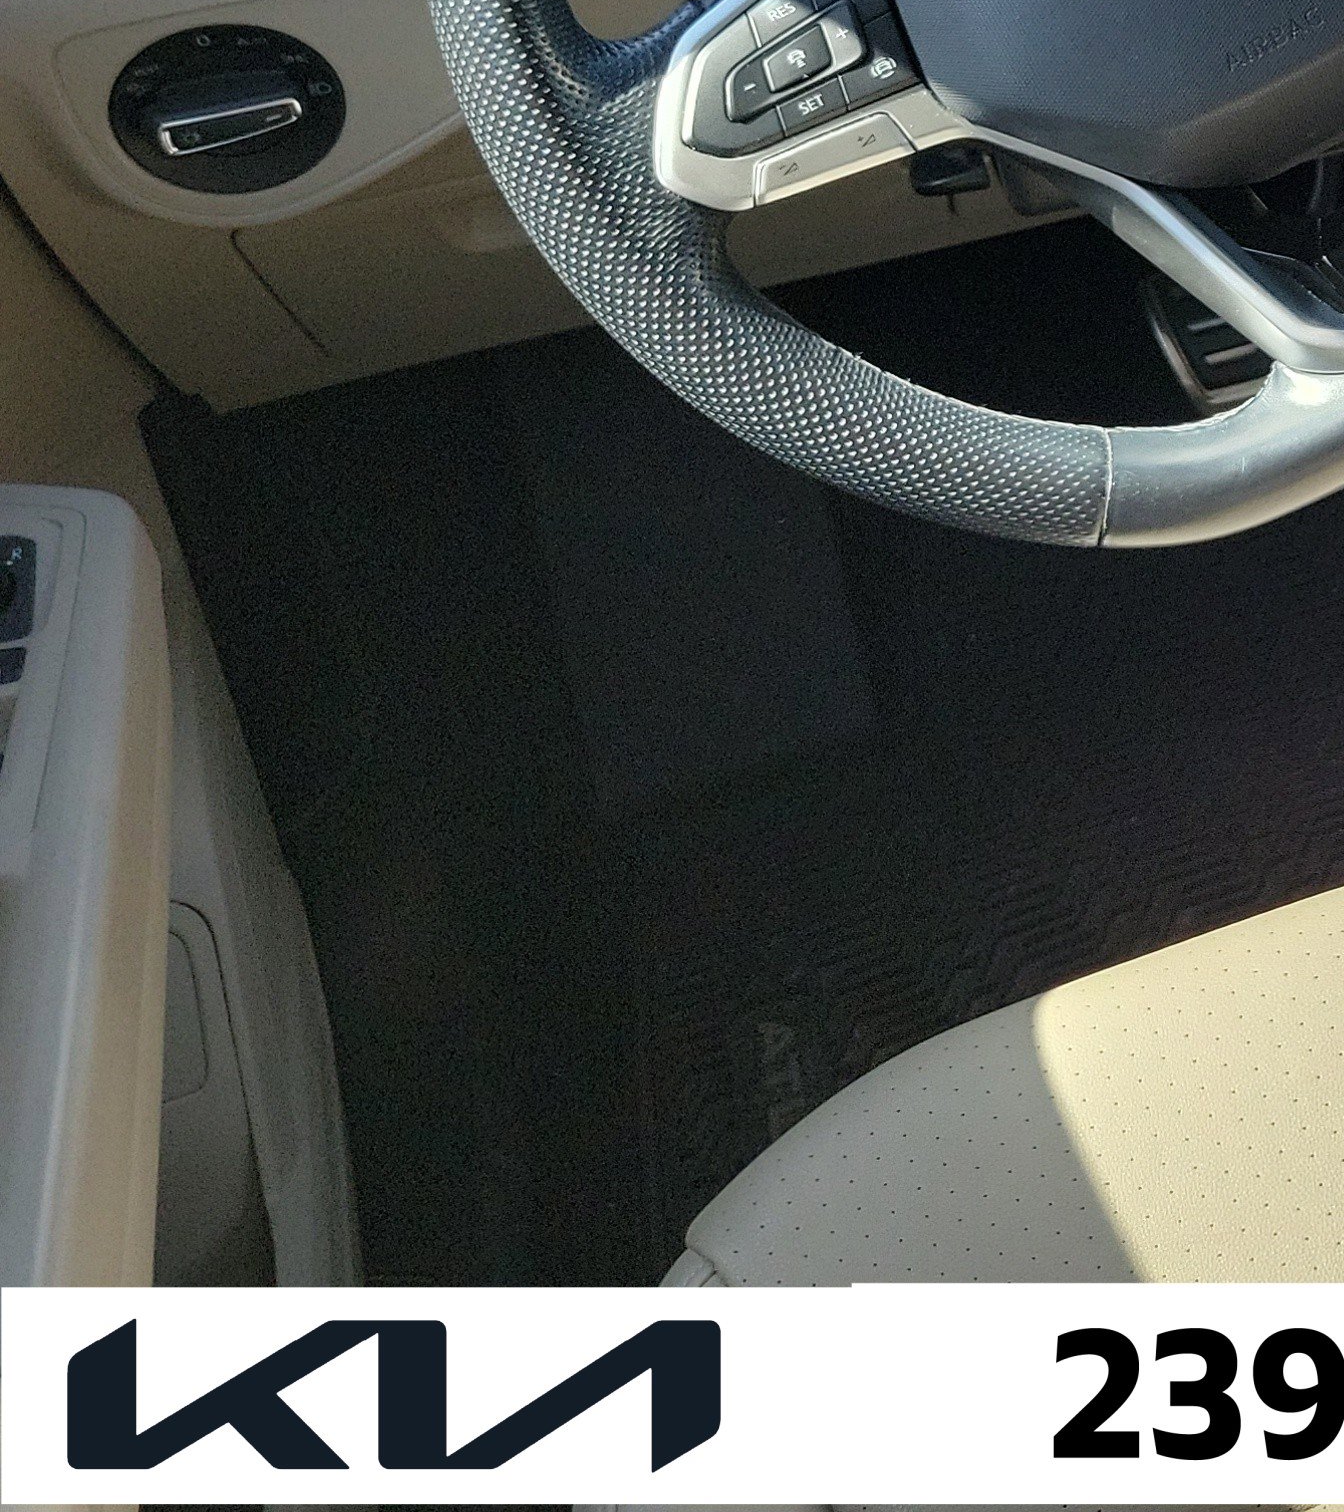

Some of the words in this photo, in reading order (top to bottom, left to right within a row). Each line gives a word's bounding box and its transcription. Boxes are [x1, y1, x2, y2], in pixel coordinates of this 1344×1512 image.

[766, 1, 797, 23] RES
[1224, 7, 1327, 72] AIRBAG
[798, 93, 825, 116] SET
